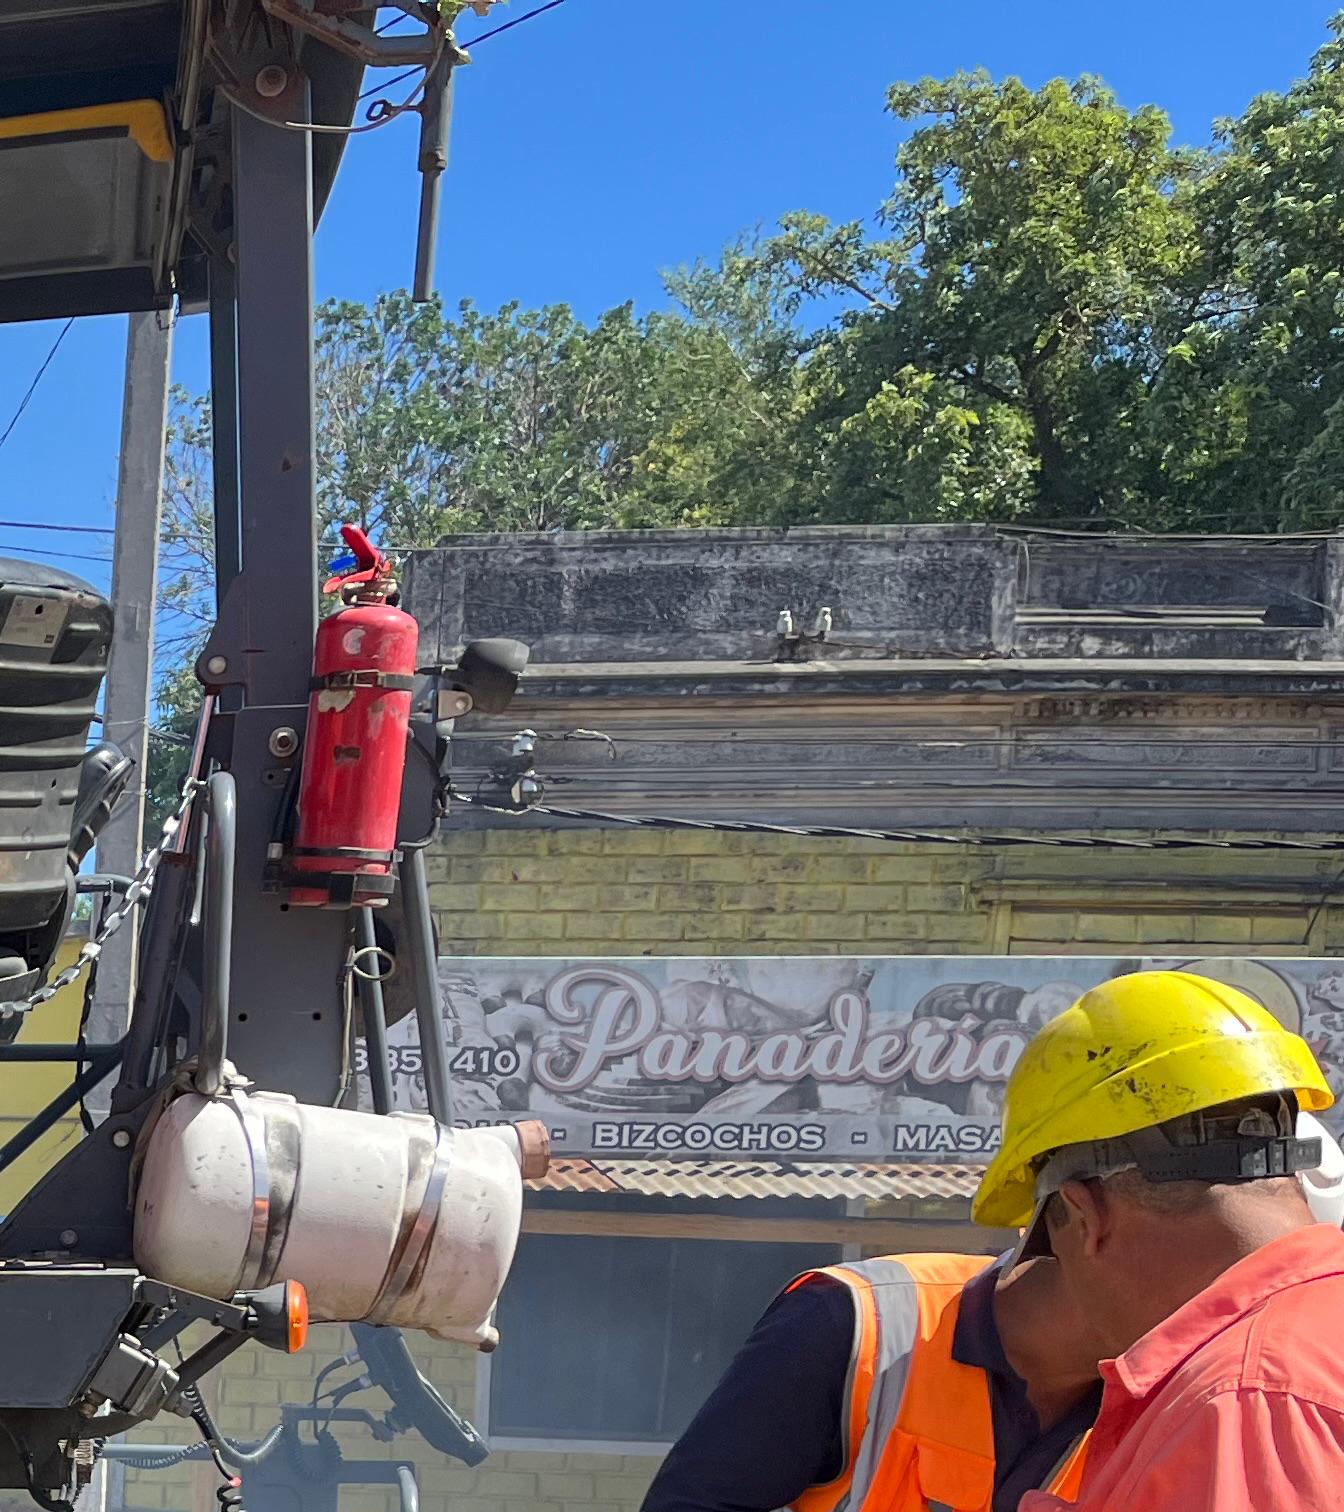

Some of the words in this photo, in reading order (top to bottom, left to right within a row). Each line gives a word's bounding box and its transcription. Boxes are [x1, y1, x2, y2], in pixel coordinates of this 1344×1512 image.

[532, 964, 1028, 1091] Panadería
[452, 1046, 518, 1076] 410
[592, 1121, 825, 1150] BIZCOCHOS
